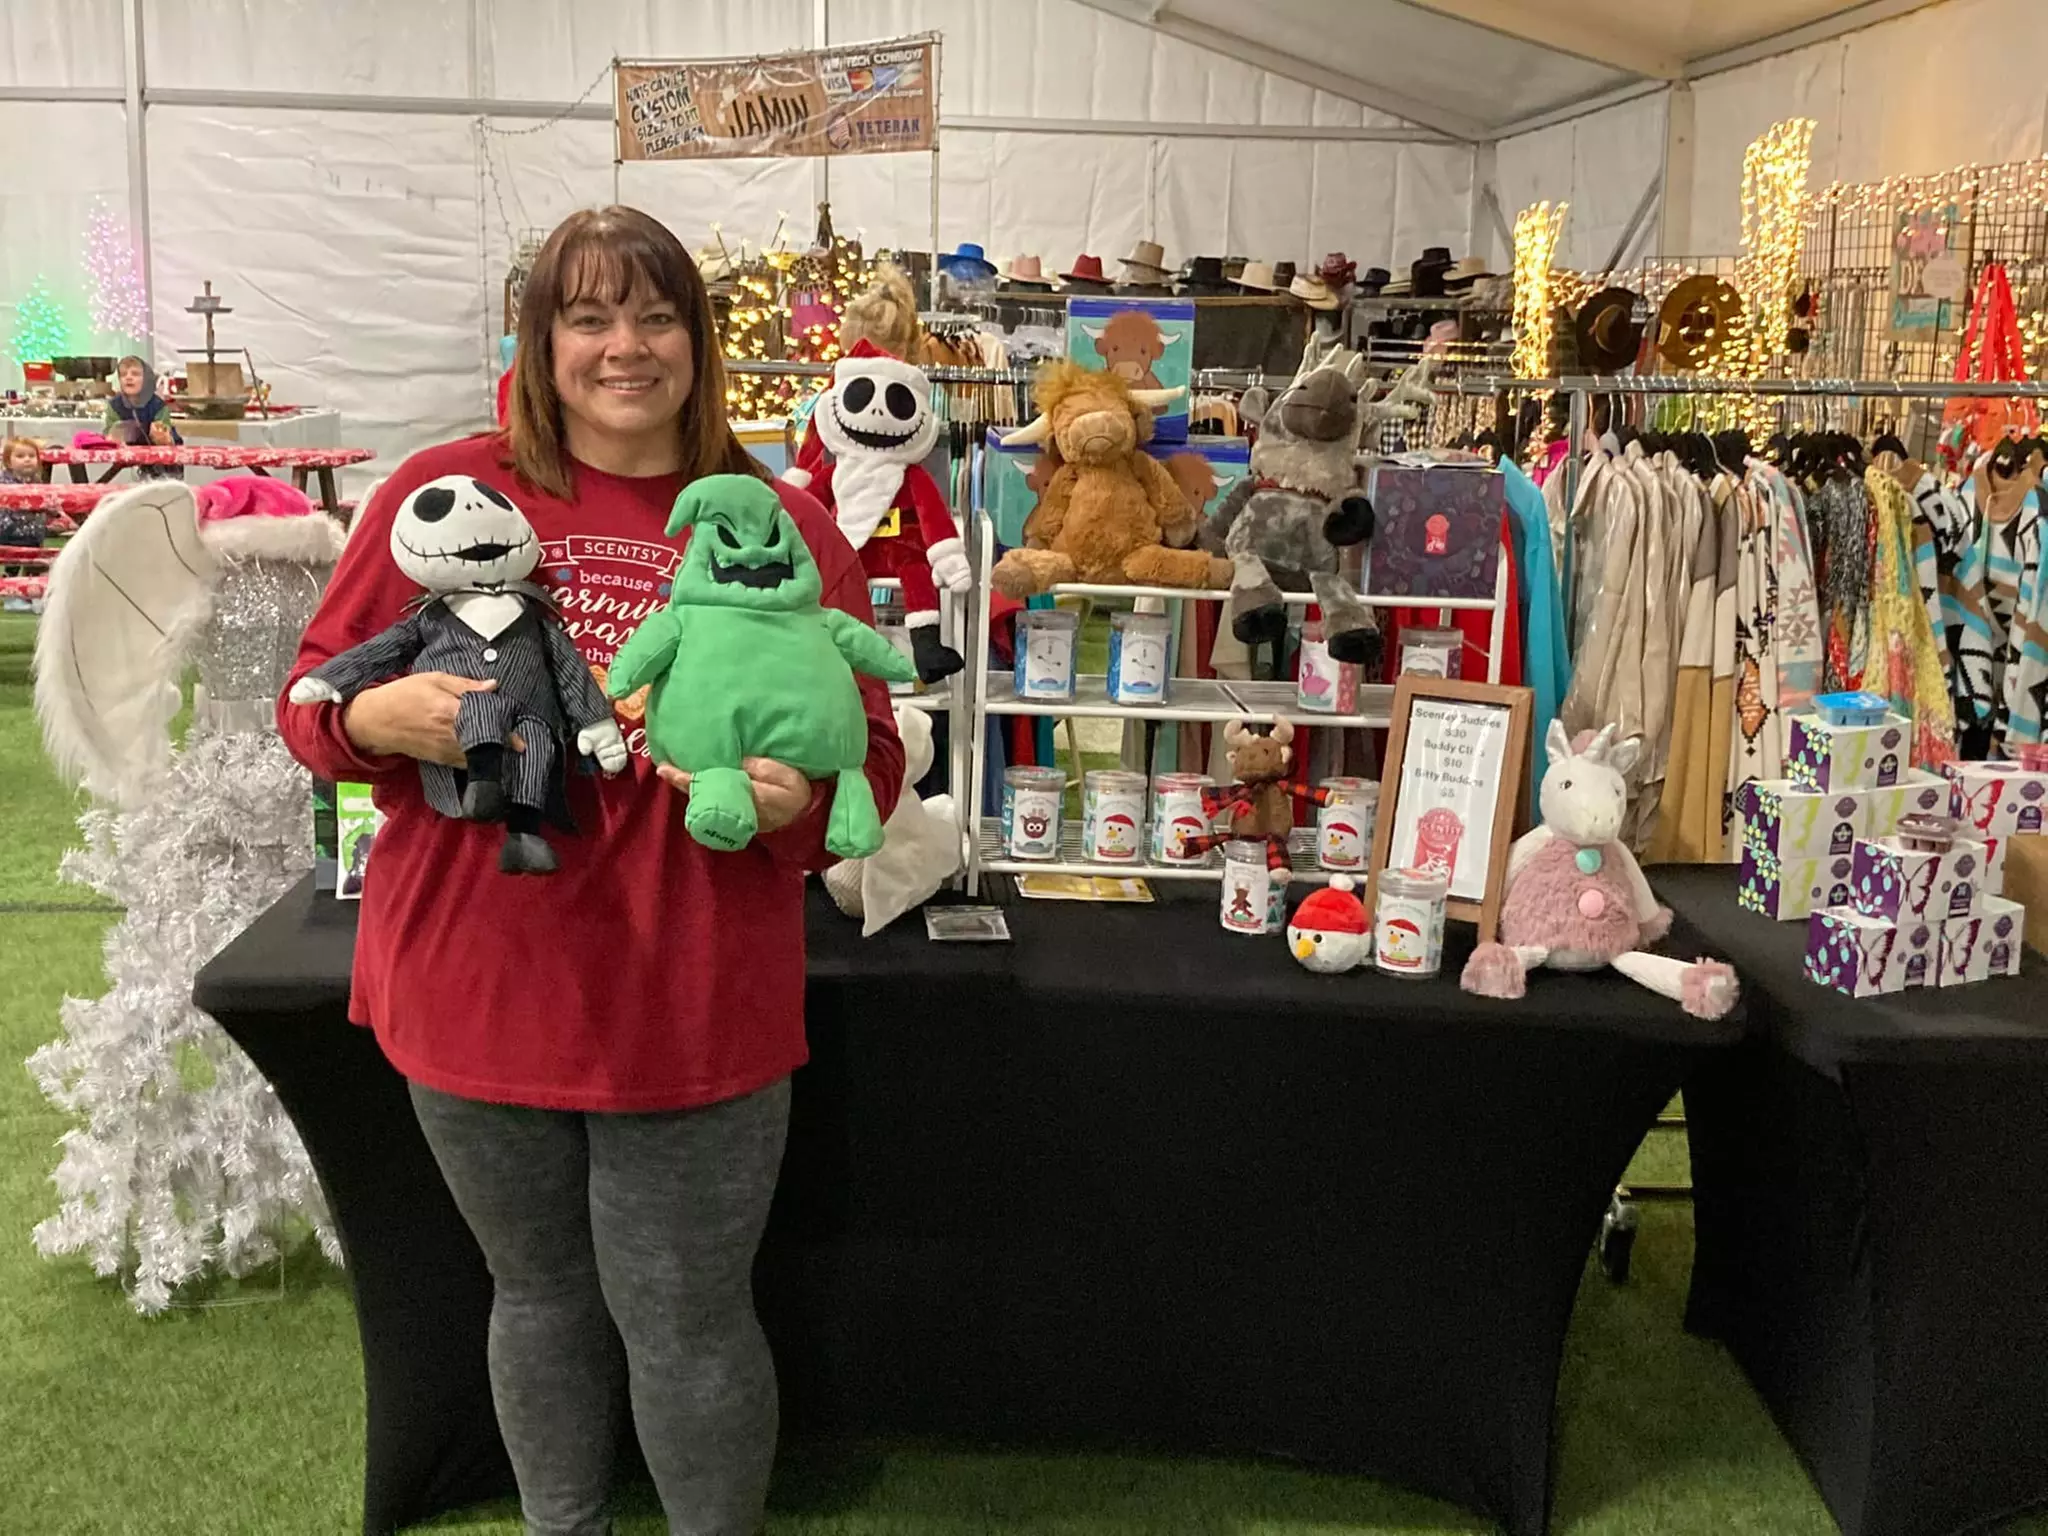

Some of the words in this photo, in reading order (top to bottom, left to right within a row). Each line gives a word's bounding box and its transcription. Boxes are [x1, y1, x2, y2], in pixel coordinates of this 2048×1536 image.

[625, 83, 649, 103] HATS
[650, 77, 670, 92] CAN
[827, 75, 849, 90] VISA
[631, 86, 691, 123] CUSTOM
[637, 119, 667, 141] SIZED
[670, 113, 685, 128] TO
[684, 107, 699, 122] FIT
[729, 94, 808, 139] JAMIN
[856, 118, 920, 136] VETERAN
[645, 132, 680, 154] PLEASE
[584, 541, 662, 562] SCENTSY
[579, 569, 654, 592] because
[550, 585, 671, 621] armin
[585, 647, 614, 664] tha
[1424, 738, 1456, 754] Buddy
[1458, 745, 1485, 758] Clis
[1443, 757, 1463, 768] $10
